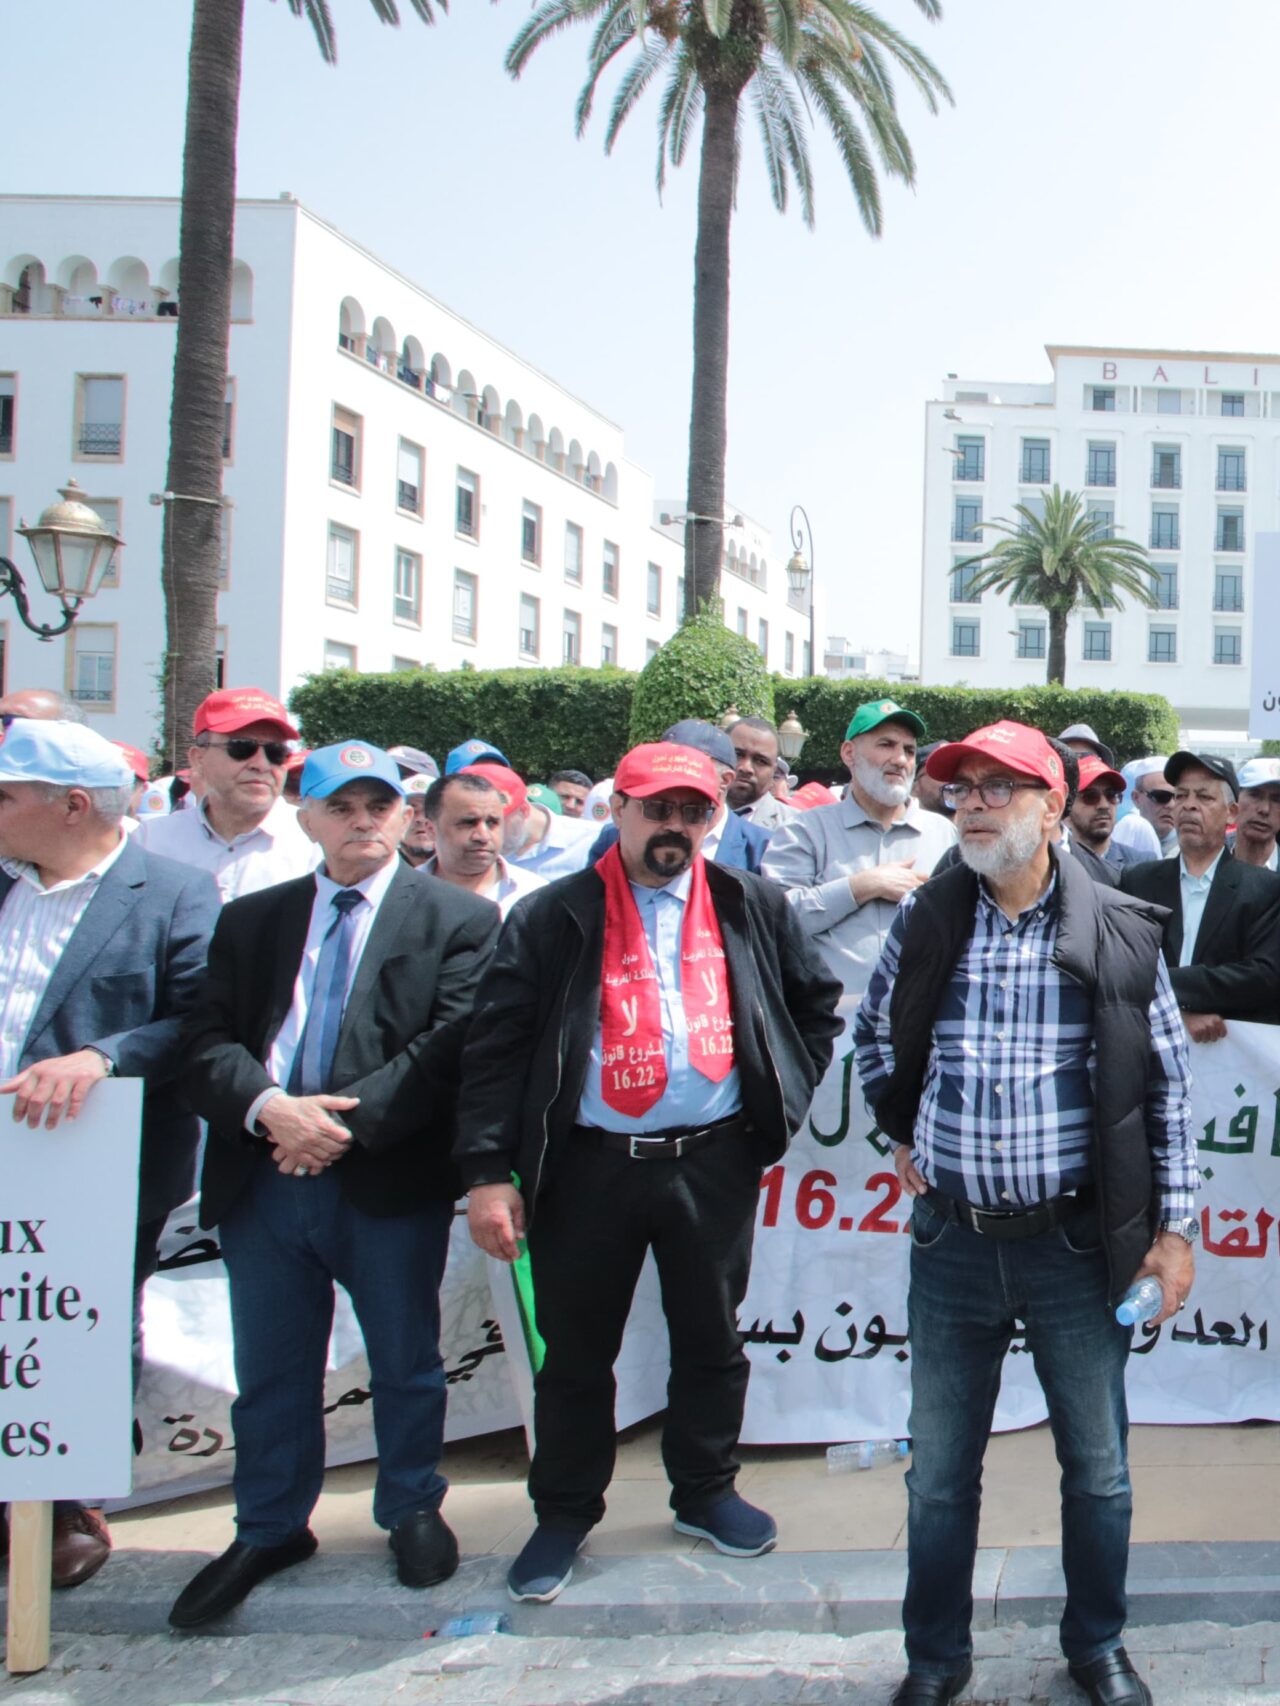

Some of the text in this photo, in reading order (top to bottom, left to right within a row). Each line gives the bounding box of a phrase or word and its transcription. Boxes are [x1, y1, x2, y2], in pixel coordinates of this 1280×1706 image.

[701, 967, 718, 1006] لا
[621, 995, 638, 1037] لا
[700, 1035, 734, 1057] 16.22
[612, 1065, 656, 1090] 16.22
[760, 1165, 911, 1233] 16.2
[1130, 1304, 1268, 1353] العدو
